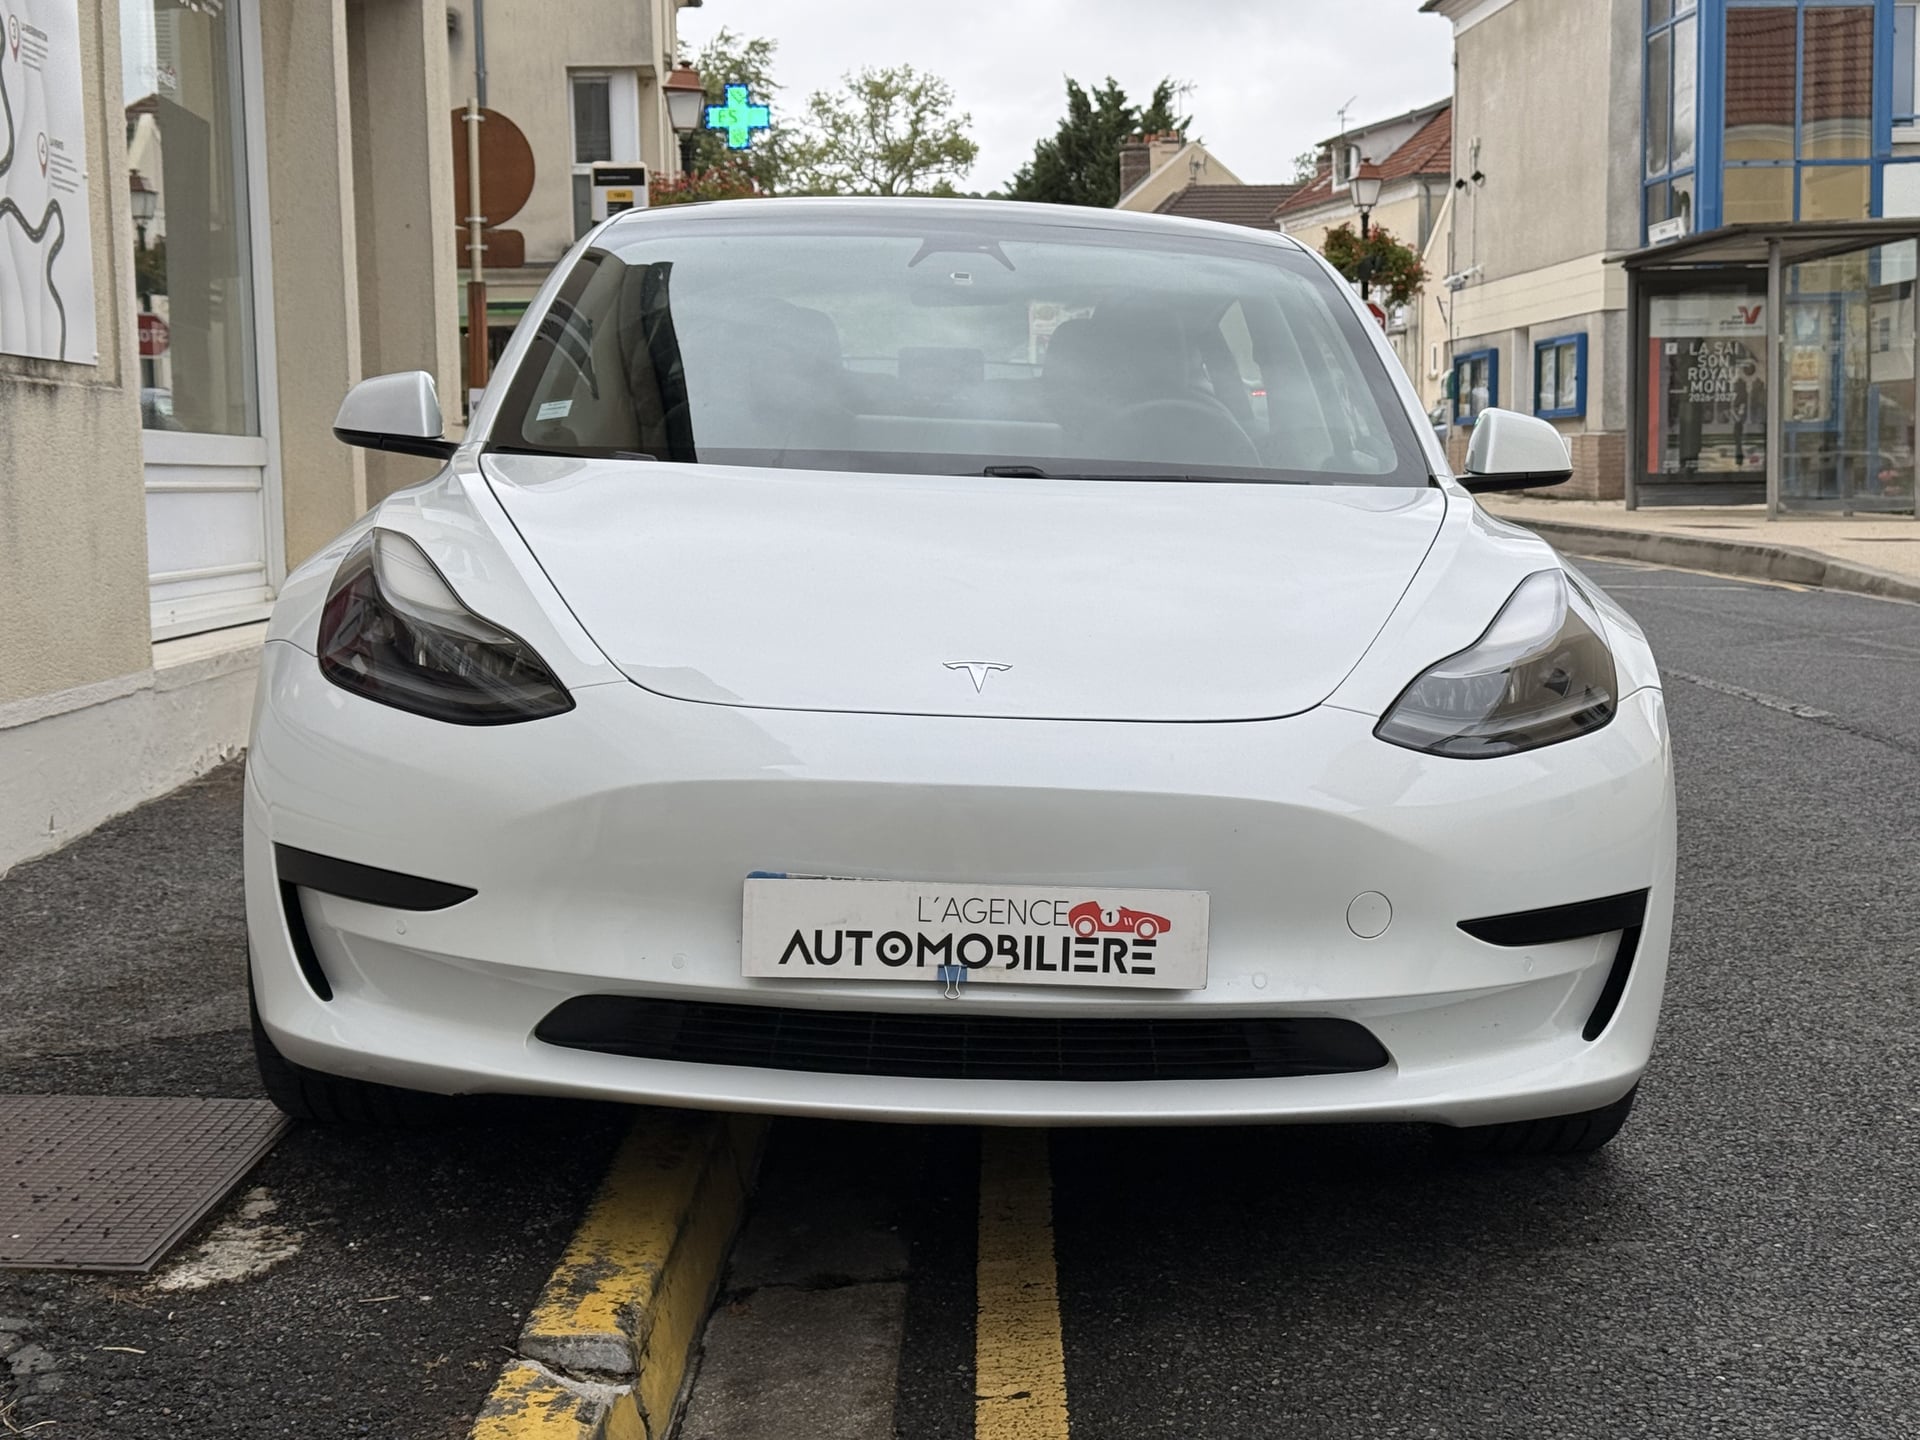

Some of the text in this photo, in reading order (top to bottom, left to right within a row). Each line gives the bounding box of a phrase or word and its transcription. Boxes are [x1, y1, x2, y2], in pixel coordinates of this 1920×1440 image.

[1689, 342, 1709, 355] LA
[1714, 342, 1739, 355] SAI
[1697, 355, 1729, 368] SON
[1688, 367, 1739, 380] ROYAU
[1690, 380, 1735, 393] MONT
[917, 896, 1069, 927] L'AGENCE
[778, 928, 1158, 975] AUTOMOBILIERE
